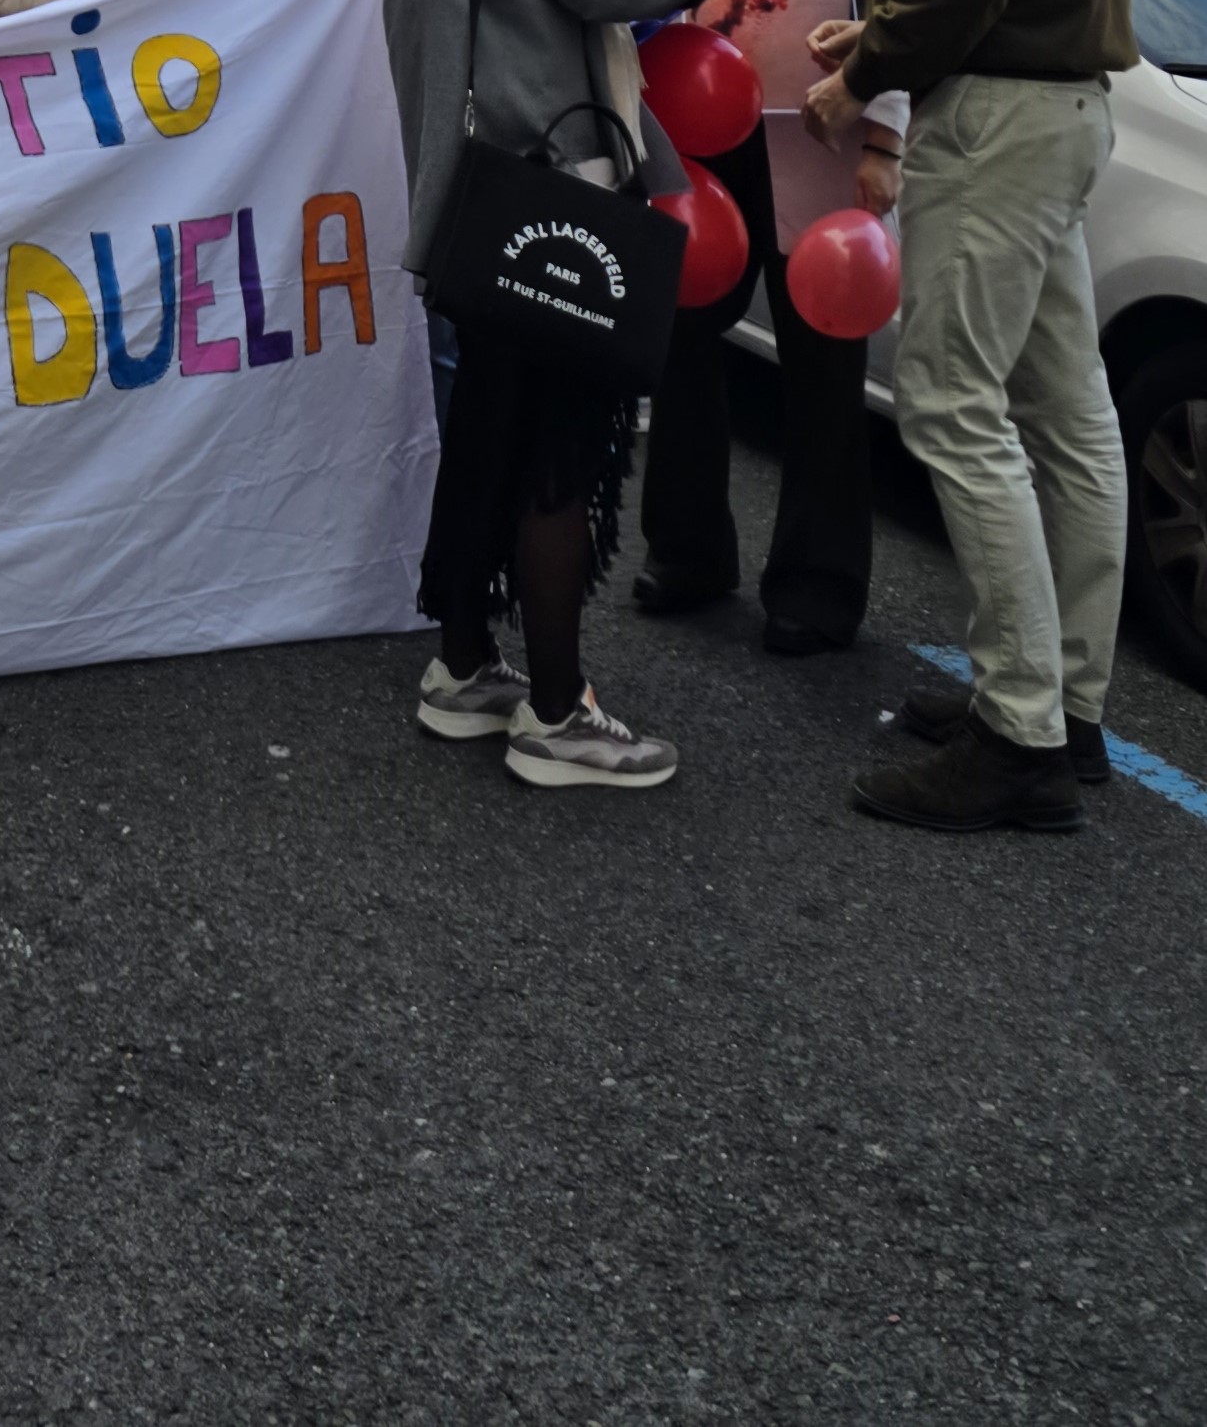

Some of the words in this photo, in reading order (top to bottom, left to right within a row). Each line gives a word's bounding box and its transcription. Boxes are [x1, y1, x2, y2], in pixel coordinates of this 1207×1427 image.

[503, 222, 549, 260] KARL
[551, 221, 626, 299] LAGERFELD
[546, 262, 581, 285] PARIS
[4, 191, 377, 407] DUELA
[497, 276, 511, 289] 21
[513, 281, 536, 299] RUE
[536, 290, 615, 329] ST-GUILLAUME
